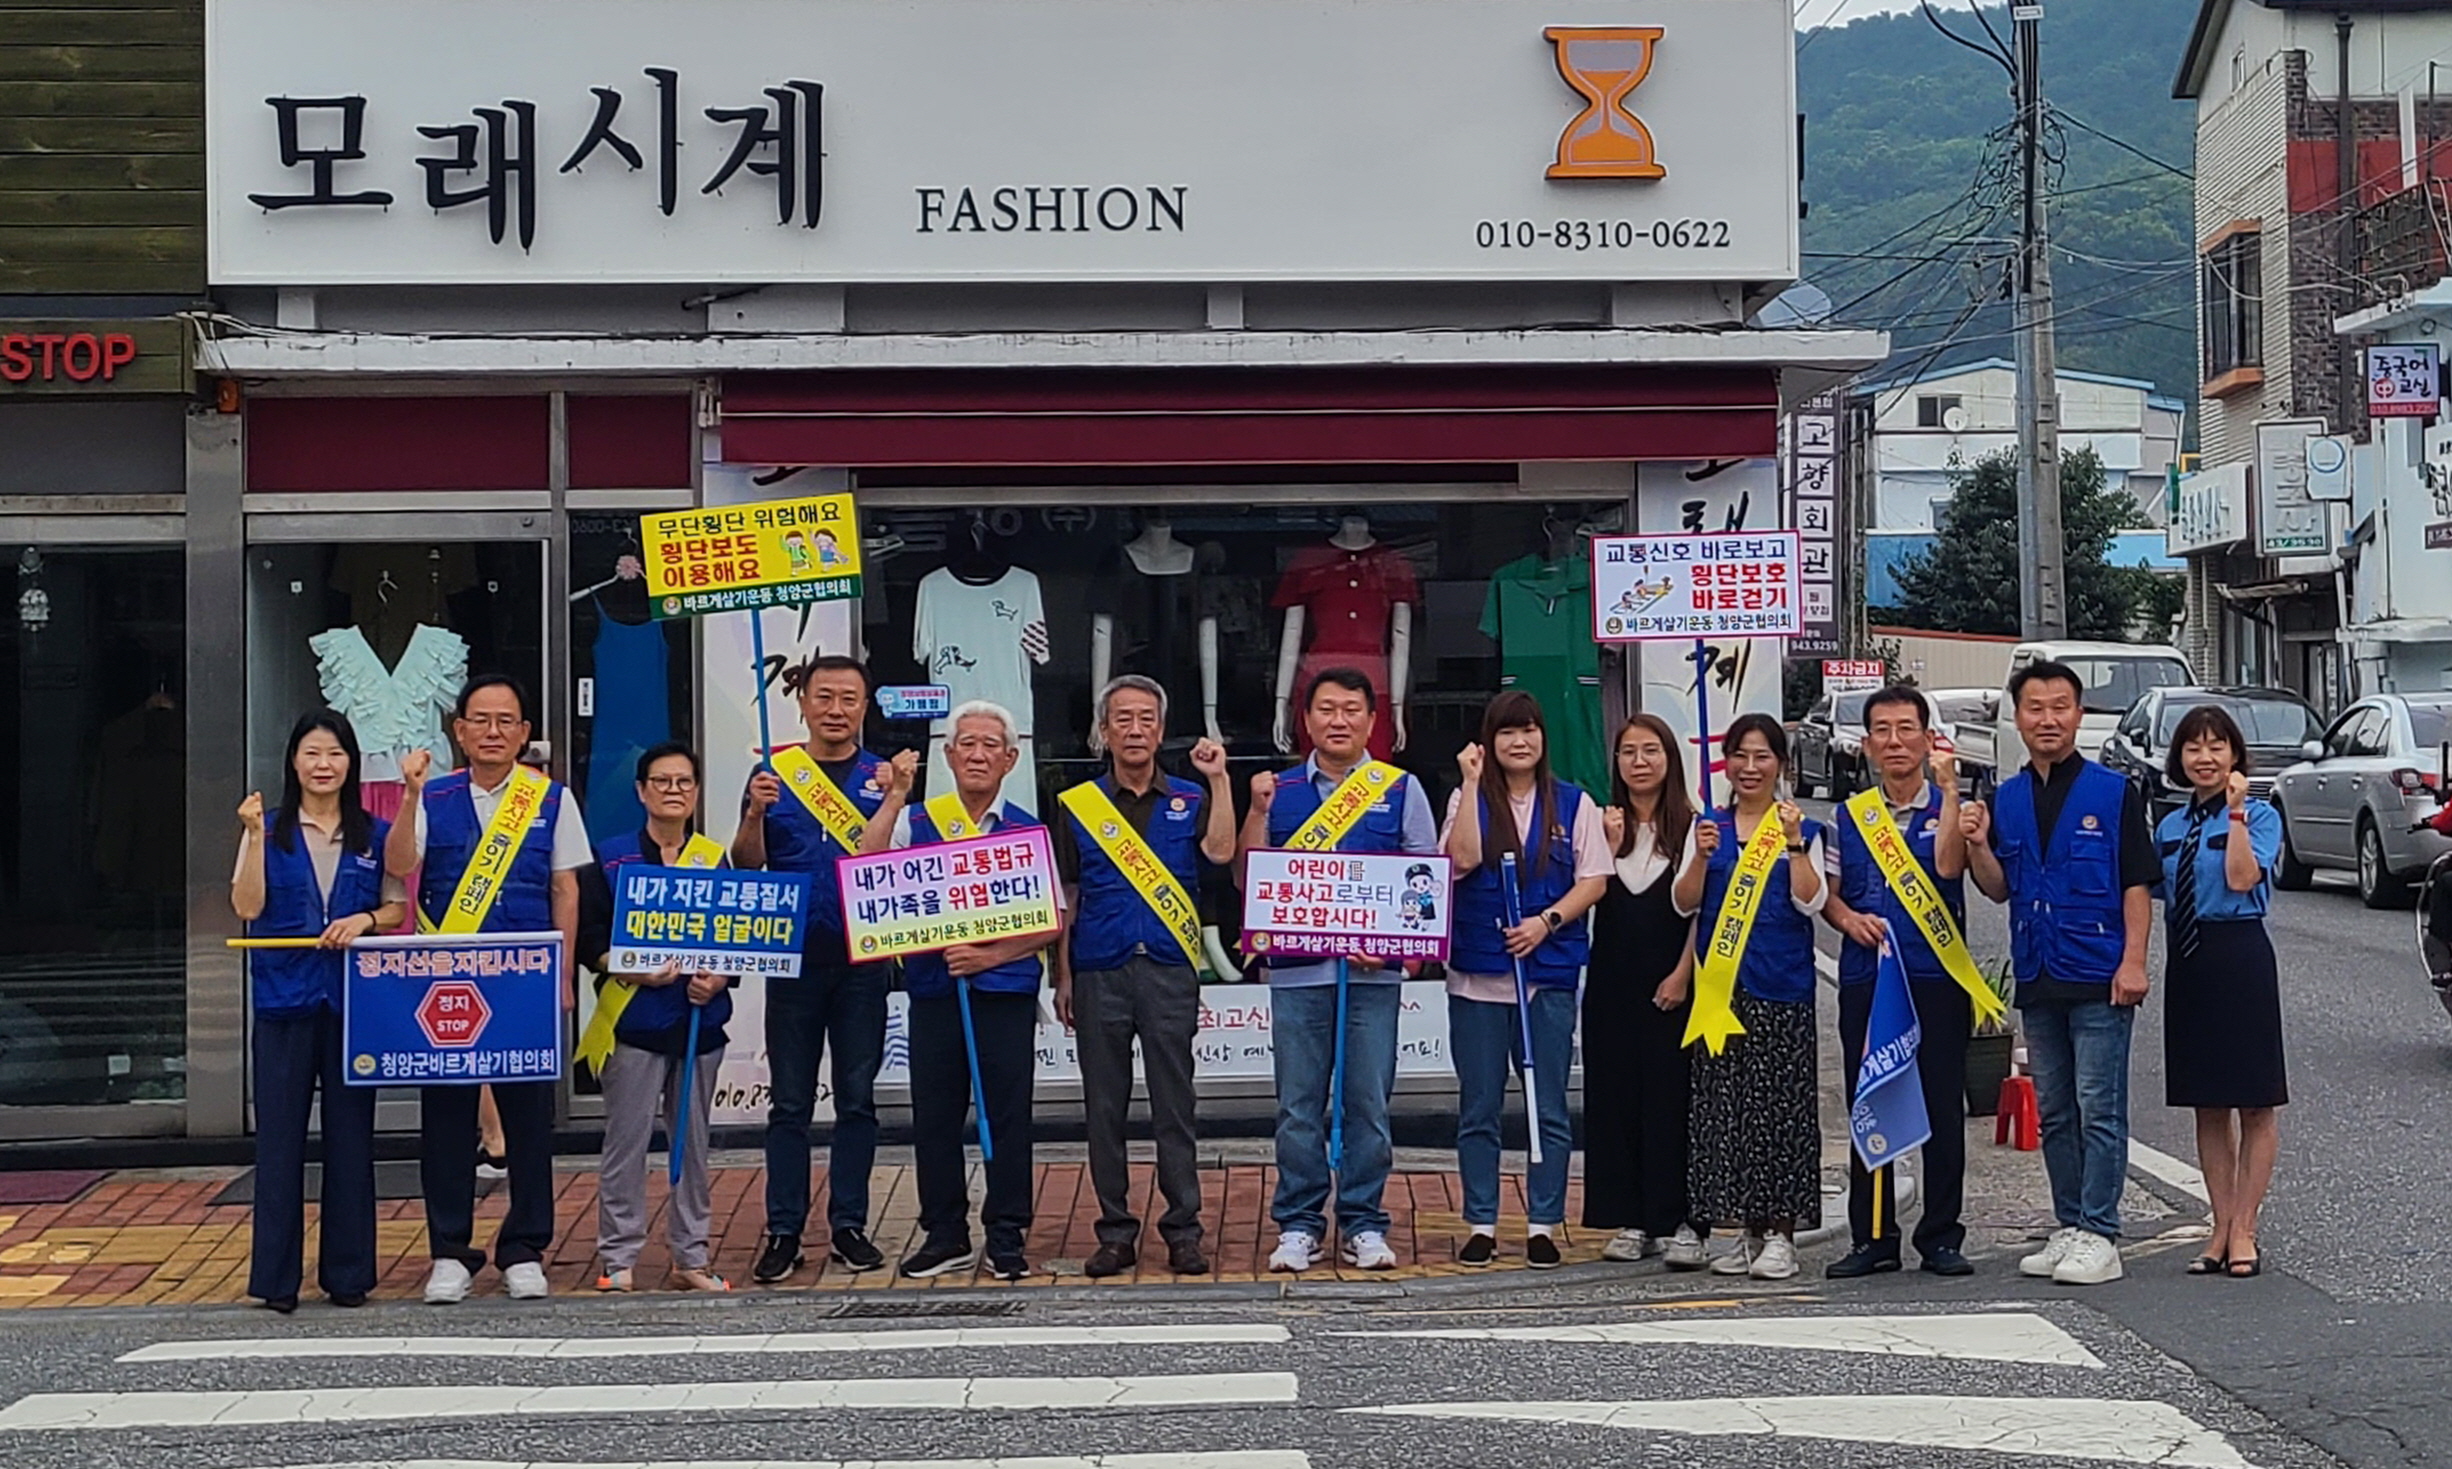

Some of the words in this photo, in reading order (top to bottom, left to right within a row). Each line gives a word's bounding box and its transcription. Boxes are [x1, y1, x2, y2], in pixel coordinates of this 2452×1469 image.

[247, 66, 826, 250] 모래시계
[915, 186, 1188, 232] FASHION
[1476, 218, 1731, 250] 010-8310-0622
[1, 333, 135, 380] STOP
[2373, 355, 2430, 378] 중국어
[2400, 378, 2432, 398] 교실
[658, 512, 745, 539] 무단횡단
[754, 502, 841, 529] 위험해요
[660, 534, 759, 564] 횡단보도
[1605, 541, 1692, 563] 교통신호
[1701, 539, 1787, 561] 바로보고
[663, 559, 761, 588] 이용해요
[1691, 563, 1788, 586] 횡단보호
[683, 587, 773, 611] 바르게살기운동
[776, 579, 852, 601] 청양군협의회
[1692, 588, 1788, 611] 바로걷기
[1626, 615, 1714, 632] 바르게살기운동
[1717, 613, 1792, 630] 청양군협의회
[1828, 661, 1879, 675] 주차금지
[498, 783, 536, 833] 교통사고
[806, 782, 854, 830] 교통사고
[1322, 781, 1371, 830] 교통사고
[479, 830, 513, 875] 줄이기
[1744, 826, 1782, 872] 교통사고
[855, 863, 896, 891] 내가
[903, 857, 944, 883] 어긴
[951, 843, 1034, 876] 교통법규
[1115, 838, 1162, 888] 교통사고
[1151, 881, 1189, 922] 줄이기
[1288, 859, 1366, 882] 어린이를
[459, 873, 494, 916] 캠페인
[627, 876, 669, 907] 내가
[672, 877, 714, 909] 지킨
[718, 881, 800, 913] 교통질서
[857, 889, 942, 924] 내가족을
[948, 875, 1041, 910] 위협한다!
[1256, 881, 1394, 905] 교통사고로부터
[1730, 872, 1757, 916] 줄이기
[1874, 826, 1907, 874] 교통사고
[1899, 869, 1934, 909] 줄이기
[1922, 903, 1954, 948] 캠페인
[626, 911, 707, 942] 대한민국
[713, 914, 794, 946] 얼굴이다
[880, 922, 968, 949] 바르게살기운동
[973, 910, 1049, 935] 청양군협의회
[1271, 906, 1377, 930] 보호합시다!
[1272, 934, 1361, 954] 바르게살기운동
[1364, 936, 1439, 956] 청양군협의회
[1717, 915, 1745, 959] 캠페인
[356, 947, 551, 978] 정지선을지킵시다
[722, 955, 792, 973] 청양군협의회
[437, 995, 469, 1013] 정지
[436, 1019, 470, 1032] STOP
[381, 1048, 555, 1077] 청양군바르게살기협의회
